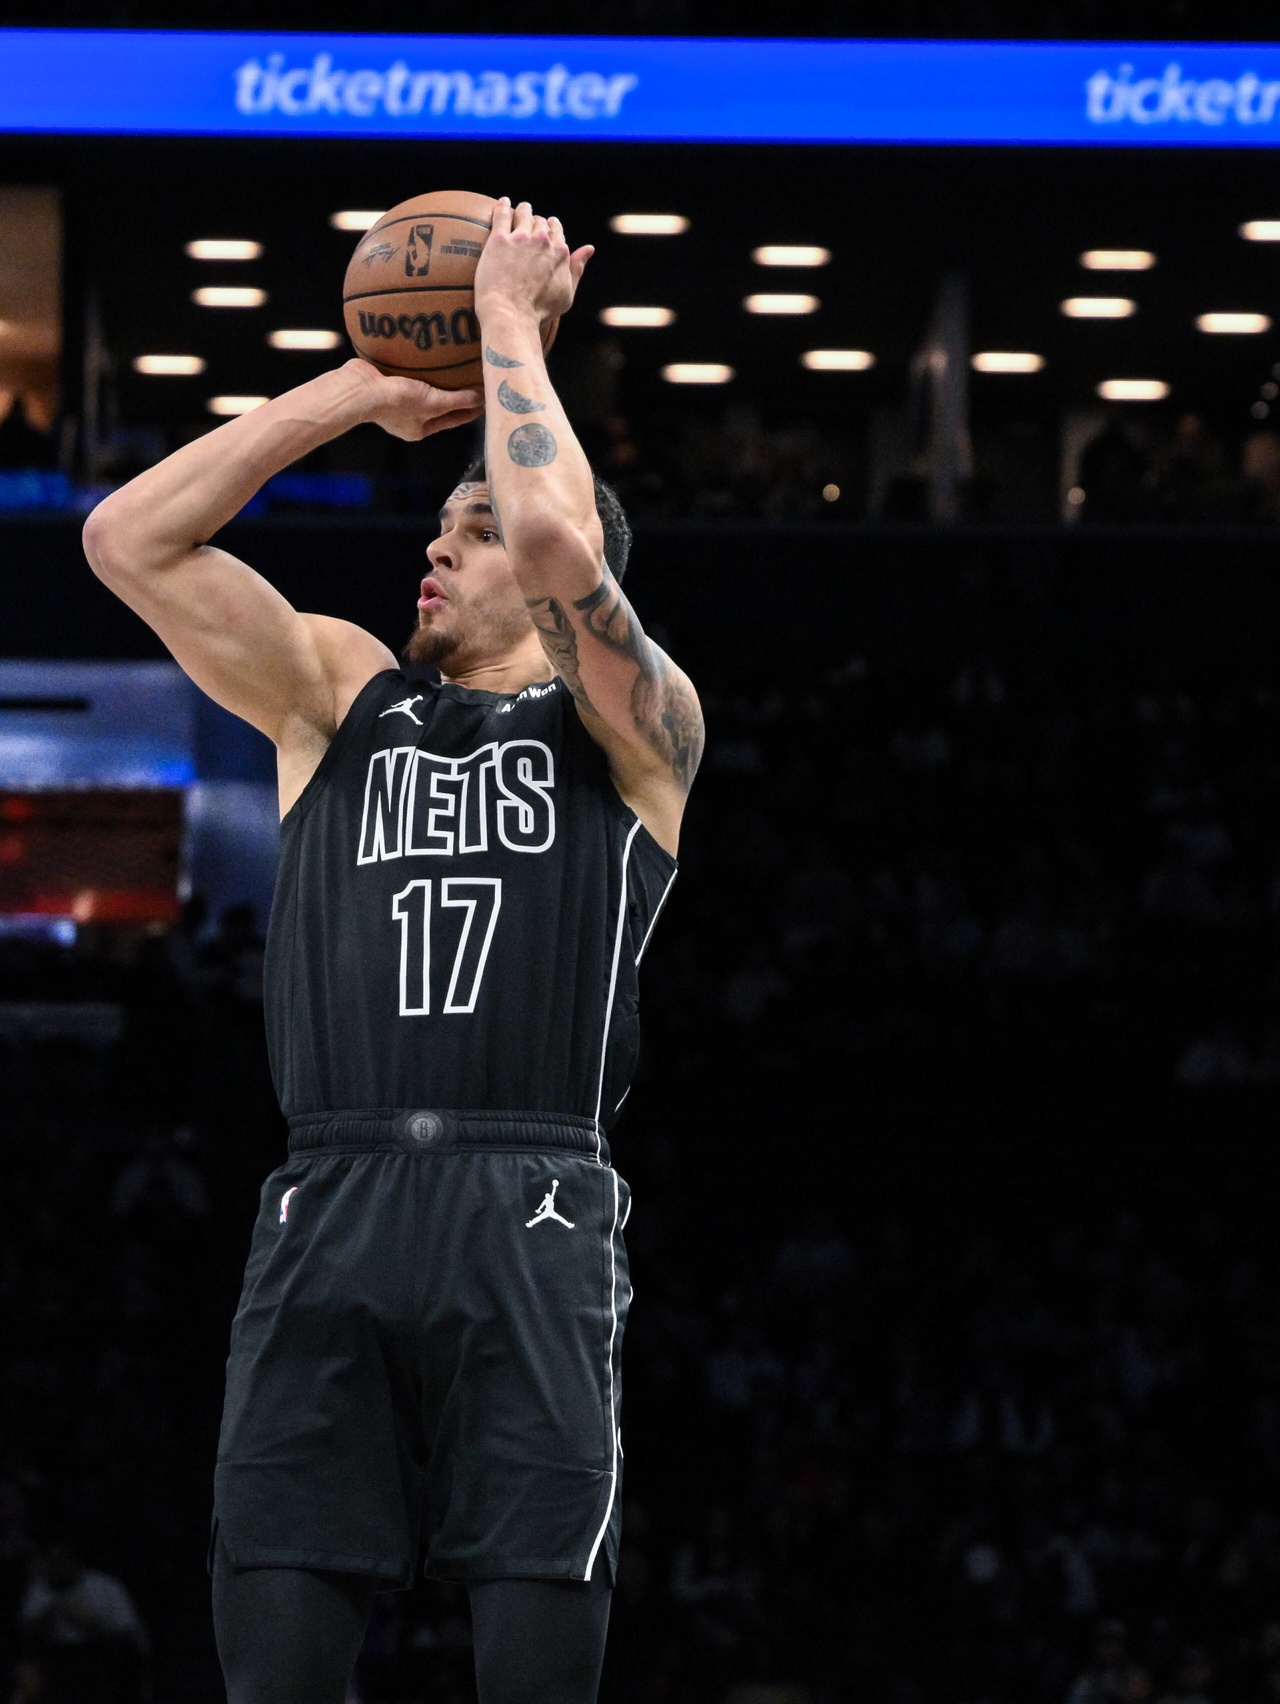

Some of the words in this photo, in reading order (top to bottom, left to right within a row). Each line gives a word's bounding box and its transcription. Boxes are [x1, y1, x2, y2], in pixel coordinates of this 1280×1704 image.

[234, 53, 638, 119] ticketmaster
[357, 739, 556, 866] NETS
[392, 877, 502, 1016] 17
